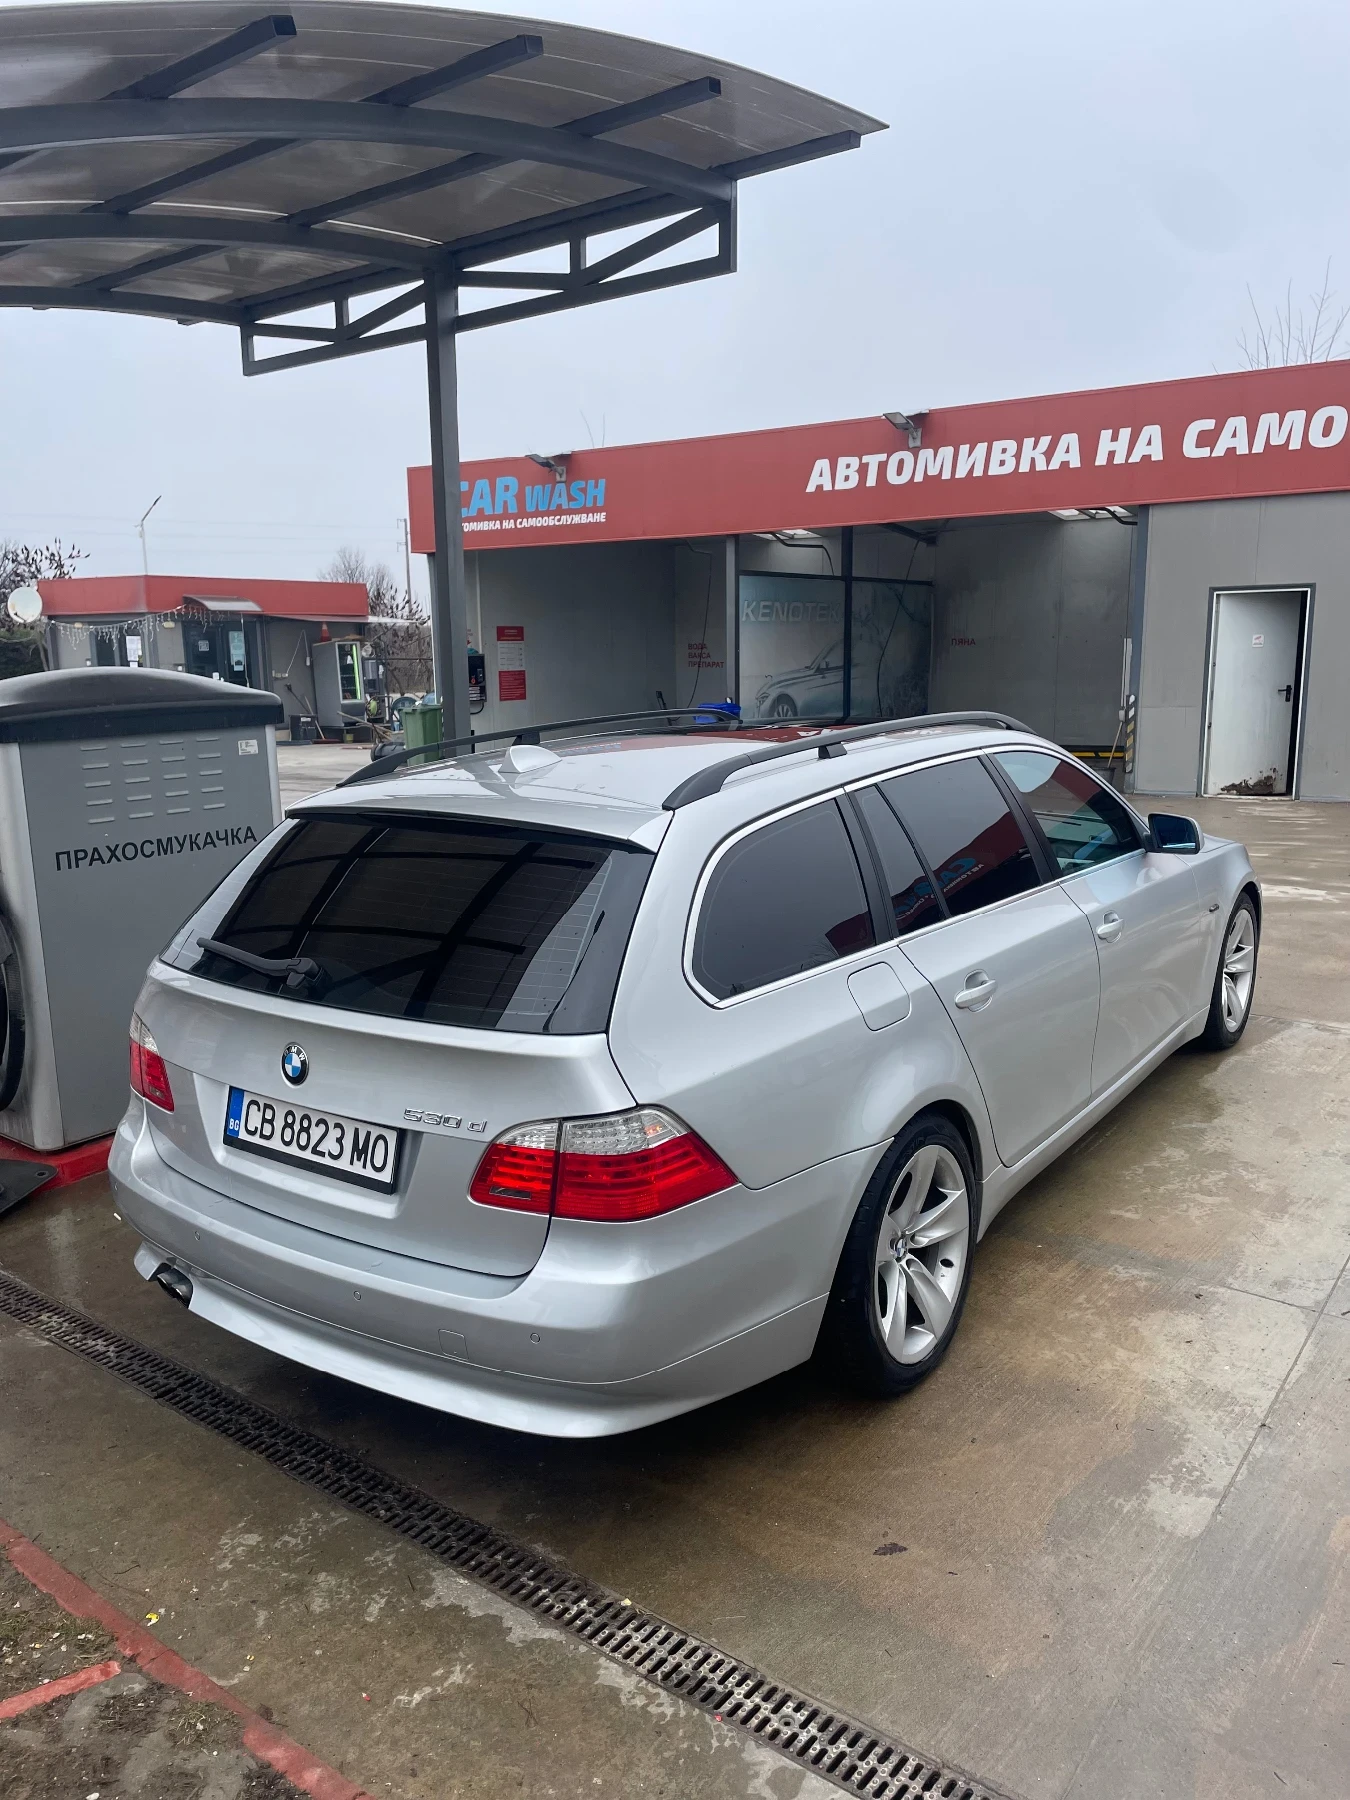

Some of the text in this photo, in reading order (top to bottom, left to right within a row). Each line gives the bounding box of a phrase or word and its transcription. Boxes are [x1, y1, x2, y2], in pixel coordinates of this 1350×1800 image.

[806, 405, 1349, 493] АВТОМИВКА НА САМО
[525, 478, 606, 512] WASH
[462, 512, 607, 532] ОМИВКА НА САМООБСЛУЖВАНЕ
[741, 600, 841, 622] KENOTEK
[951, 637, 976, 646] ПЯНА
[55, 825, 258, 871] ПРАХОСМУКАЧКА
[229, 1117, 240, 1131] BG
[244, 1099, 389, 1173] CB 8823 MO
